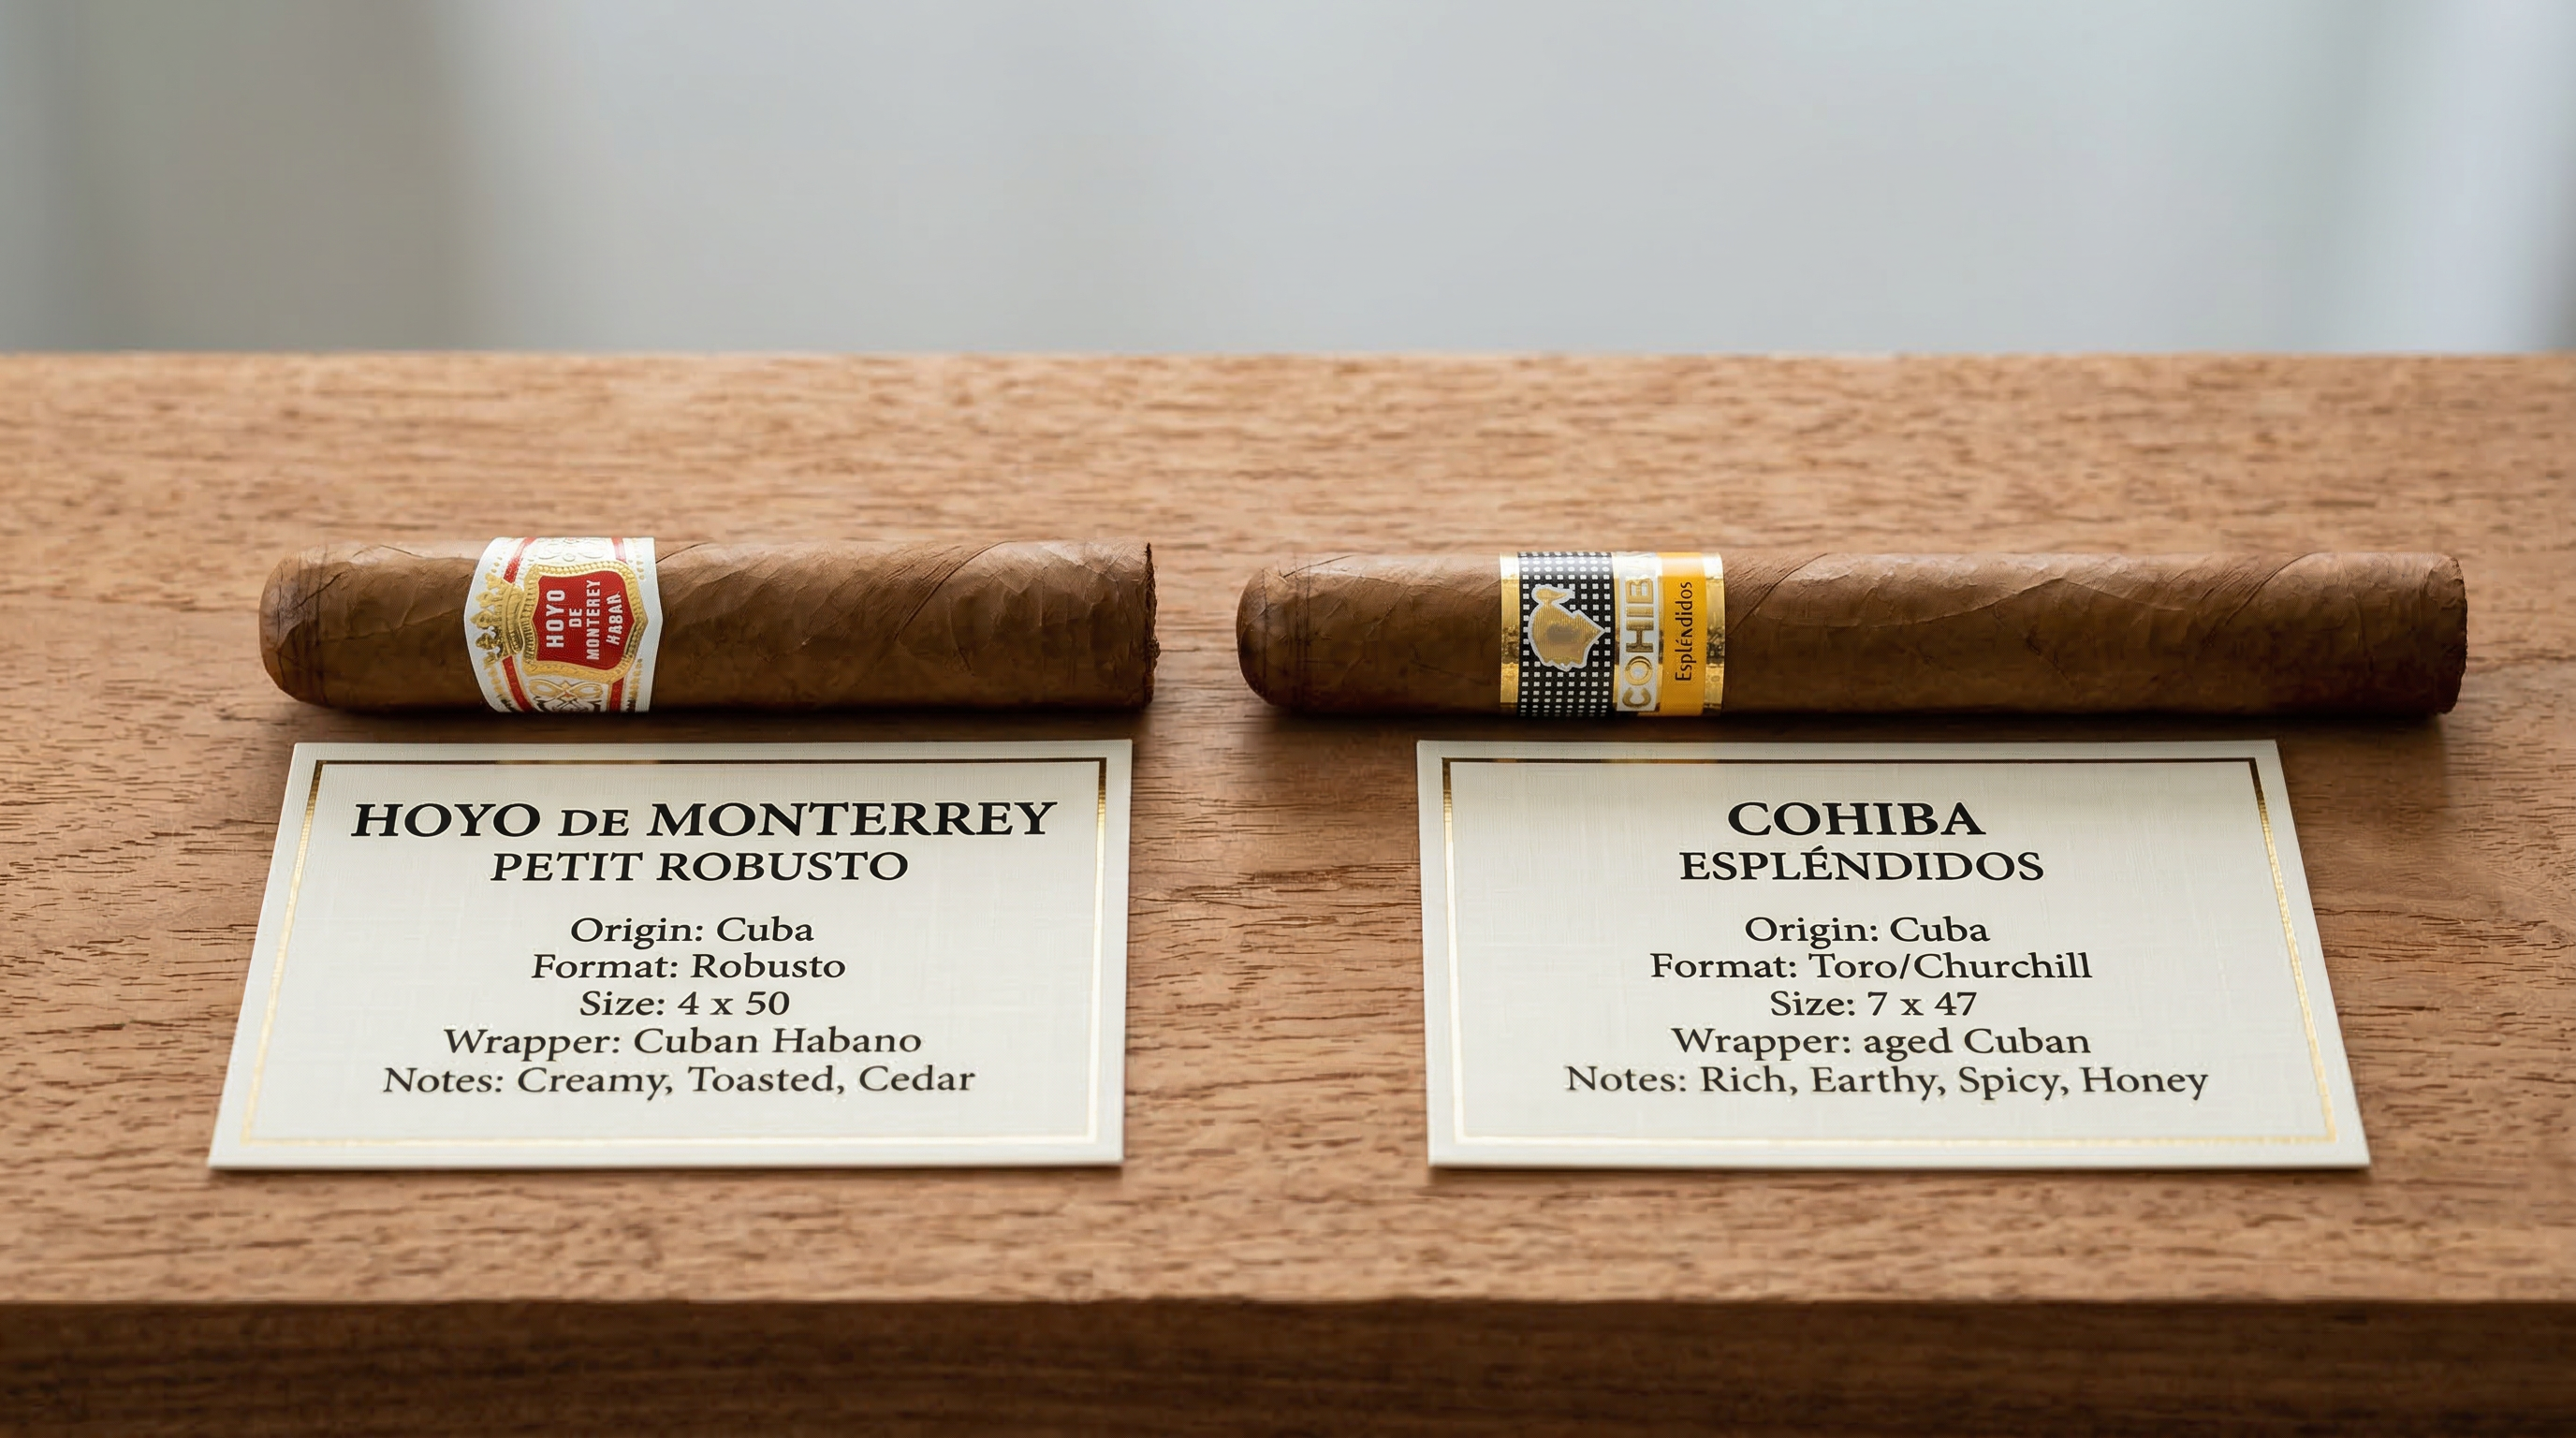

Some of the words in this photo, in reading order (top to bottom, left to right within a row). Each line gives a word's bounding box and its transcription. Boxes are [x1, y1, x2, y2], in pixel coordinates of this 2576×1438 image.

[546, 589, 566, 648] HOYO
[568, 608, 583, 628] DE
[586, 580, 601, 661] MONTEREY
[350, 802, 541, 838] HOYO
[557, 809, 630, 837] DE
[646, 801, 1059, 837] MONTERREY
[1727, 801, 1987, 836] COHIBA
[490, 851, 644, 882] PETIT
[655, 851, 908, 882] ROBUSTO
[1678, 844, 2044, 881] ESPLÉNDIDOS
[571, 917, 703, 950] Origin:
[716, 915, 814, 942] Cuba
[1745, 917, 1879, 950] Origin:
[1890, 915, 1991, 943] Cuba
[531, 954, 678, 979] Format:
[690, 951, 846, 978] Robusto
[1649, 952, 1797, 978] Format:
[1808, 951, 2093, 980] Toro/Churchill
[579, 990, 665, 1017] Size:
[677, 990, 700, 1016] 4
[710, 998, 734, 1016] x
[745, 990, 790, 1016] 50
[1770, 990, 1855, 1017] Size:
[1867, 990, 1888, 1017] 7
[1900, 998, 1925, 1016] x
[1934, 991, 1977, 1017] 47
[443, 1029, 621, 1063] Wrapper:
[634, 1026, 758, 1054] Cuban
[772, 1025, 922, 1053] Habano
[1670, 1027, 1851, 1062] Wrapper:
[1863, 1026, 1954, 1063] aged
[1964, 1026, 2091, 1054] Cuban
[383, 1067, 504, 1093] Notes:
[518, 1066, 673, 1101] Creamy,
[687, 1064, 844, 1094] Toasted,
[859, 1064, 975, 1092] Cedar
[1567, 1065, 1687, 1093] Notes:
[1700, 1064, 1798, 1095] Rich,
[1810, 1065, 1946, 1102] Earthy,
[1958, 1066, 2069, 1101] Spicy,
[2081, 1066, 2209, 1101] Honey
